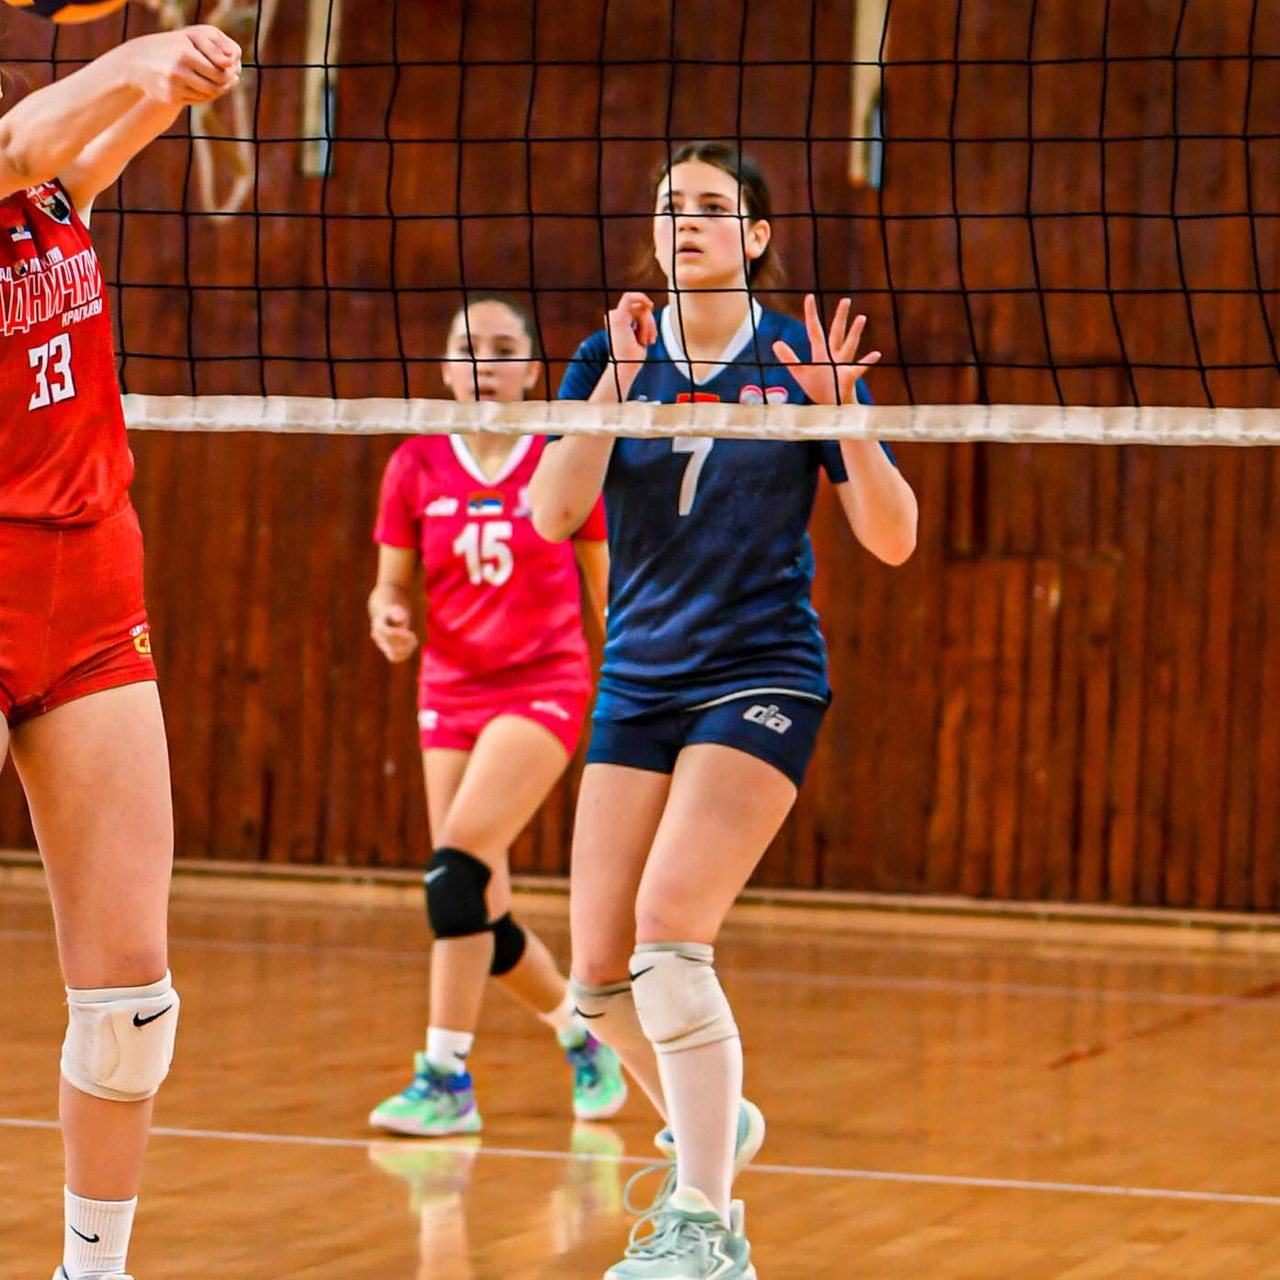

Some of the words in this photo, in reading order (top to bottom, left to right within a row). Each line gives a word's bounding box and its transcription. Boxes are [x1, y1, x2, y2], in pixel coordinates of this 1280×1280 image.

[28, 332, 76, 412] 33
[671, 436, 715, 516] 7
[452, 520, 514, 587] 15
